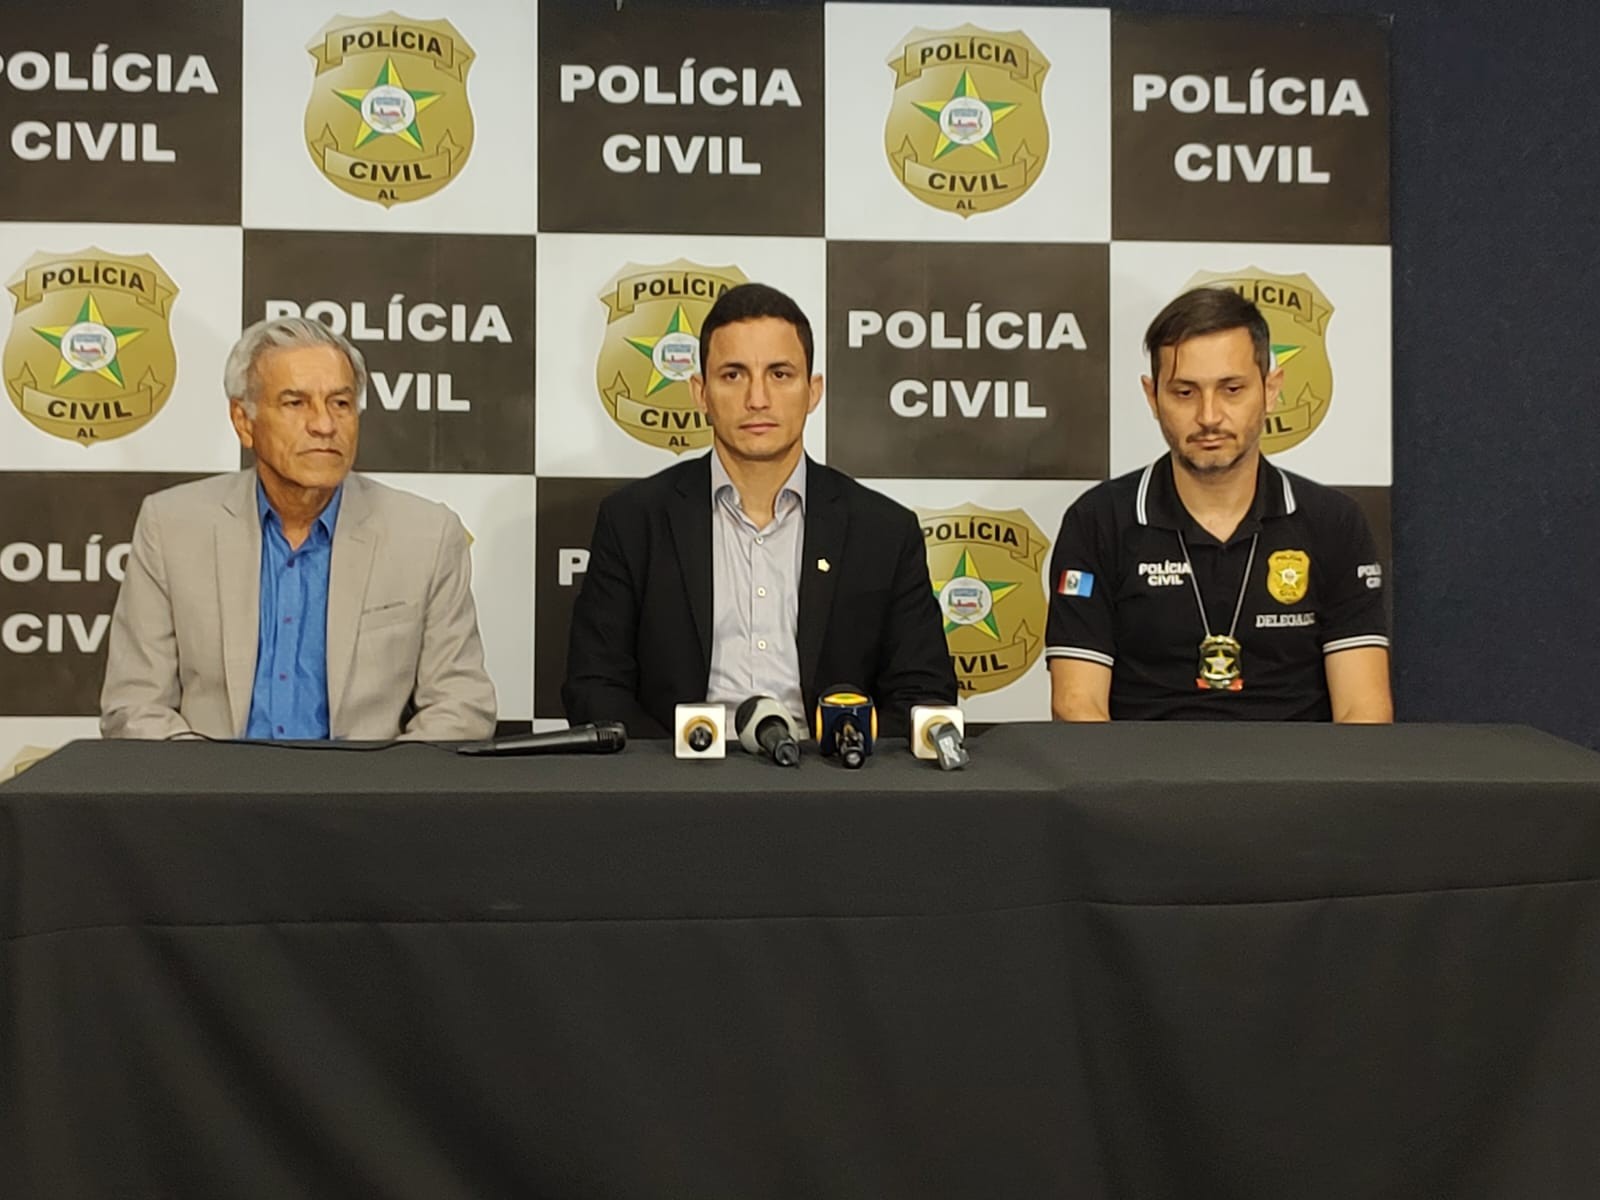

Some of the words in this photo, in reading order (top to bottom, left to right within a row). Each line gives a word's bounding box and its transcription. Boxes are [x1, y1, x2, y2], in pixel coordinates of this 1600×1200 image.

[342, 25, 442, 56] POLÍCIA
[920, 37, 1018, 68] POLÍCIA
[0, 43, 219, 94] OLÍCIA
[560, 58, 803, 107] POLÍCIA
[1133, 68, 1370, 116] POLÍCIA
[11, 121, 176, 162] CIVIL
[602, 134, 761, 175] CIVIL
[349, 162, 432, 182] CIVIL
[1174, 143, 1331, 184] CIVIL
[378, 189, 399, 200] AL
[928, 173, 1009, 193] CIVIL
[956, 199, 976, 210] AL
[42, 261, 145, 292] POLÍCIA
[848, 303, 1087, 350] POLÍCIA
[360, 372, 471, 412] VIL
[889, 379, 1047, 418] CIVIL
[47, 400, 133, 420] CIVIL
[76, 428, 98, 438] AL
[668, 436, 690, 447] AL
[0, 534, 132, 582] OLÍC
[1138, 559, 1192, 576] POLÍCIA
[1147, 574, 1184, 587] CIVIL
[2, 612, 111, 654] CIV
[953, 653, 1009, 674] VIL
